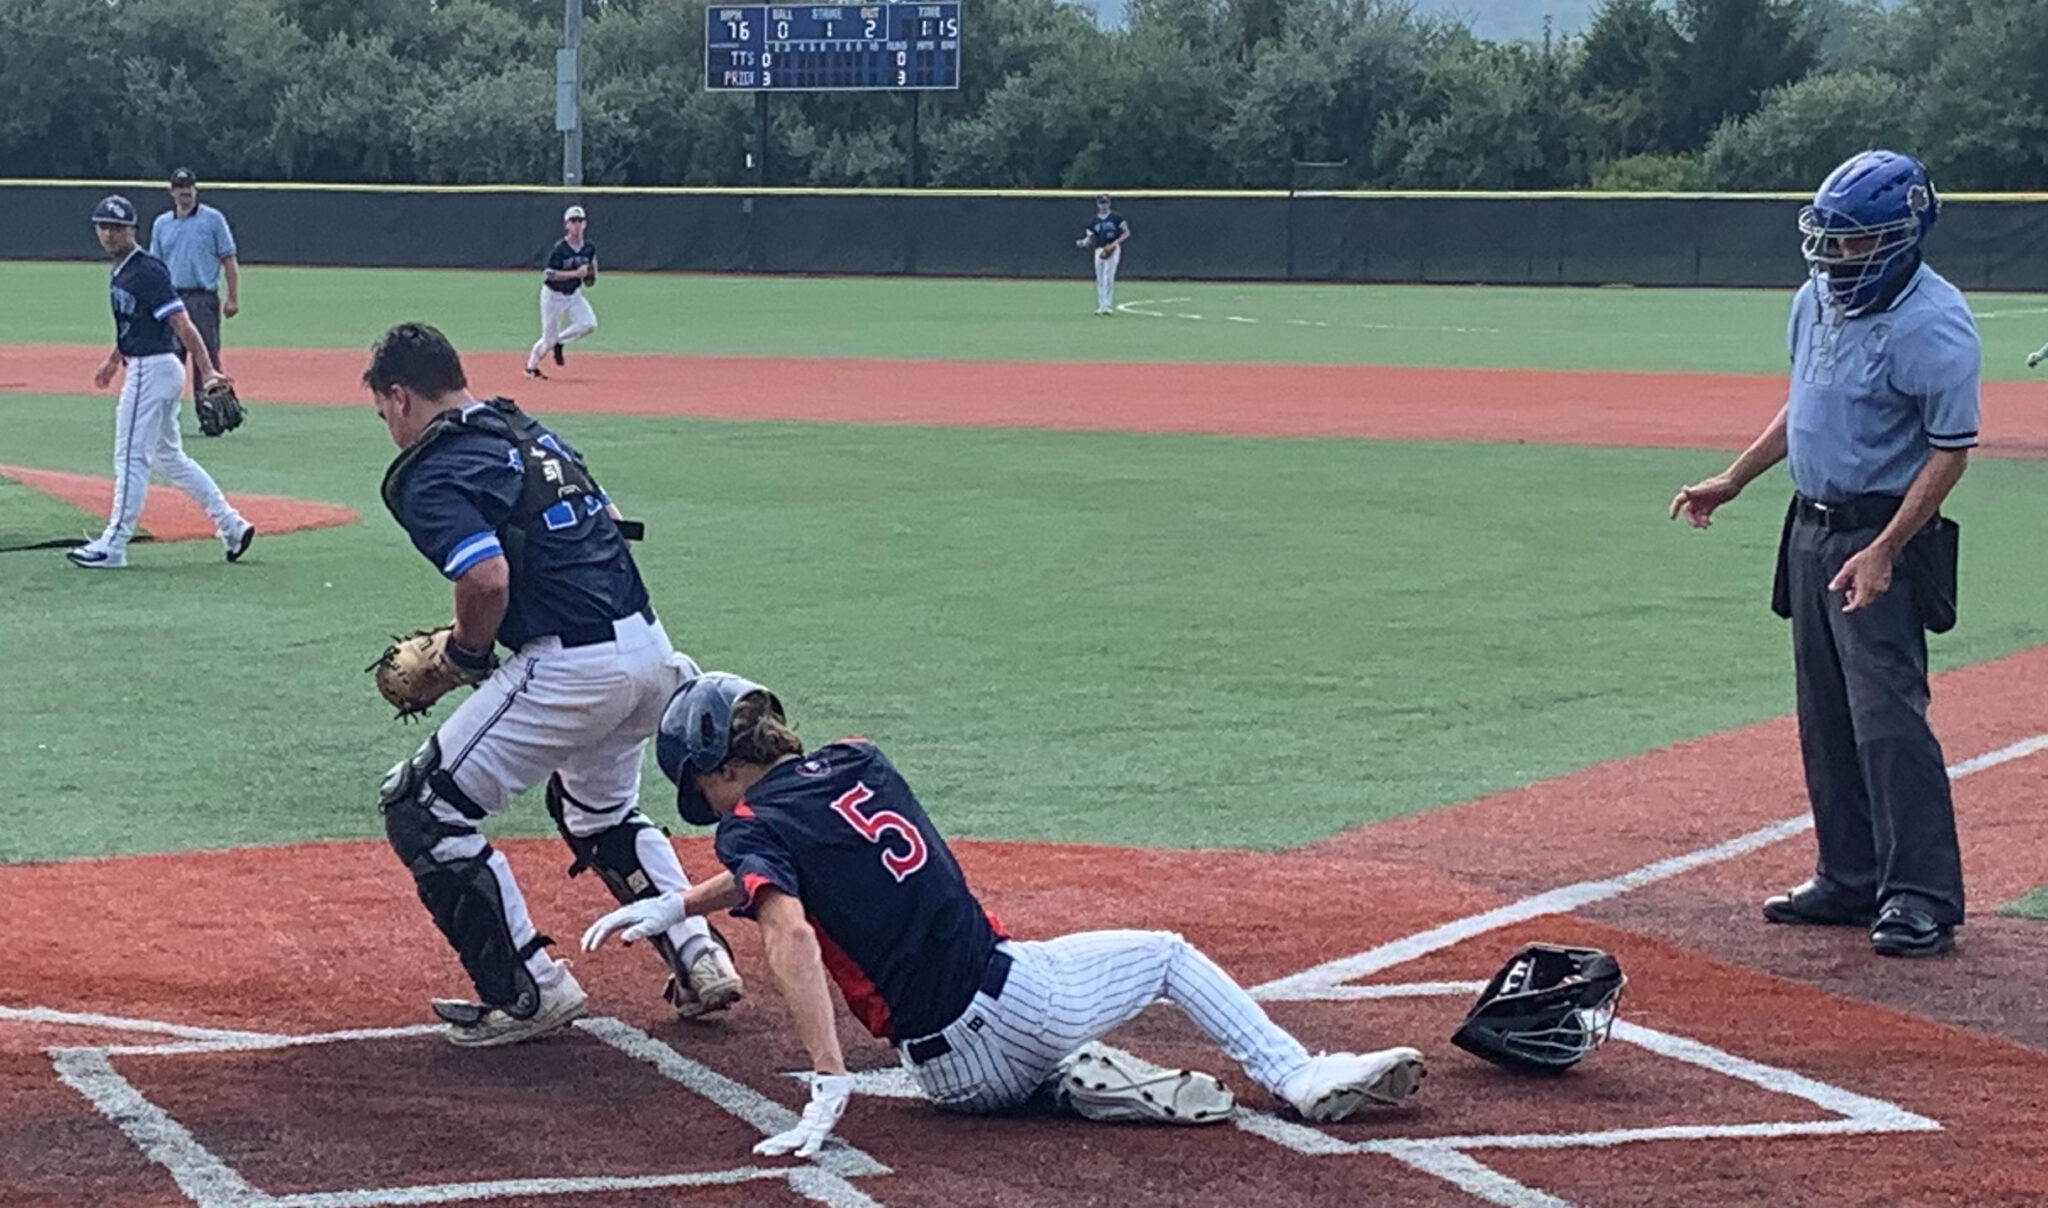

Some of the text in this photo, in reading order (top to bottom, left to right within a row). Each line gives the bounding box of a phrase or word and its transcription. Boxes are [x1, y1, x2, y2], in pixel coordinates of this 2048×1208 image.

[727, 21, 750, 40] 76
[777, 21, 789, 39] 0
[864, 20, 877, 39] 2
[730, 51, 755, 66] TTS
[762, 52, 771, 68] 0
[896, 51, 906, 66] 0
[762, 71, 771, 86] 3
[897, 70, 906, 86] 3
[829, 780, 928, 884] 5
